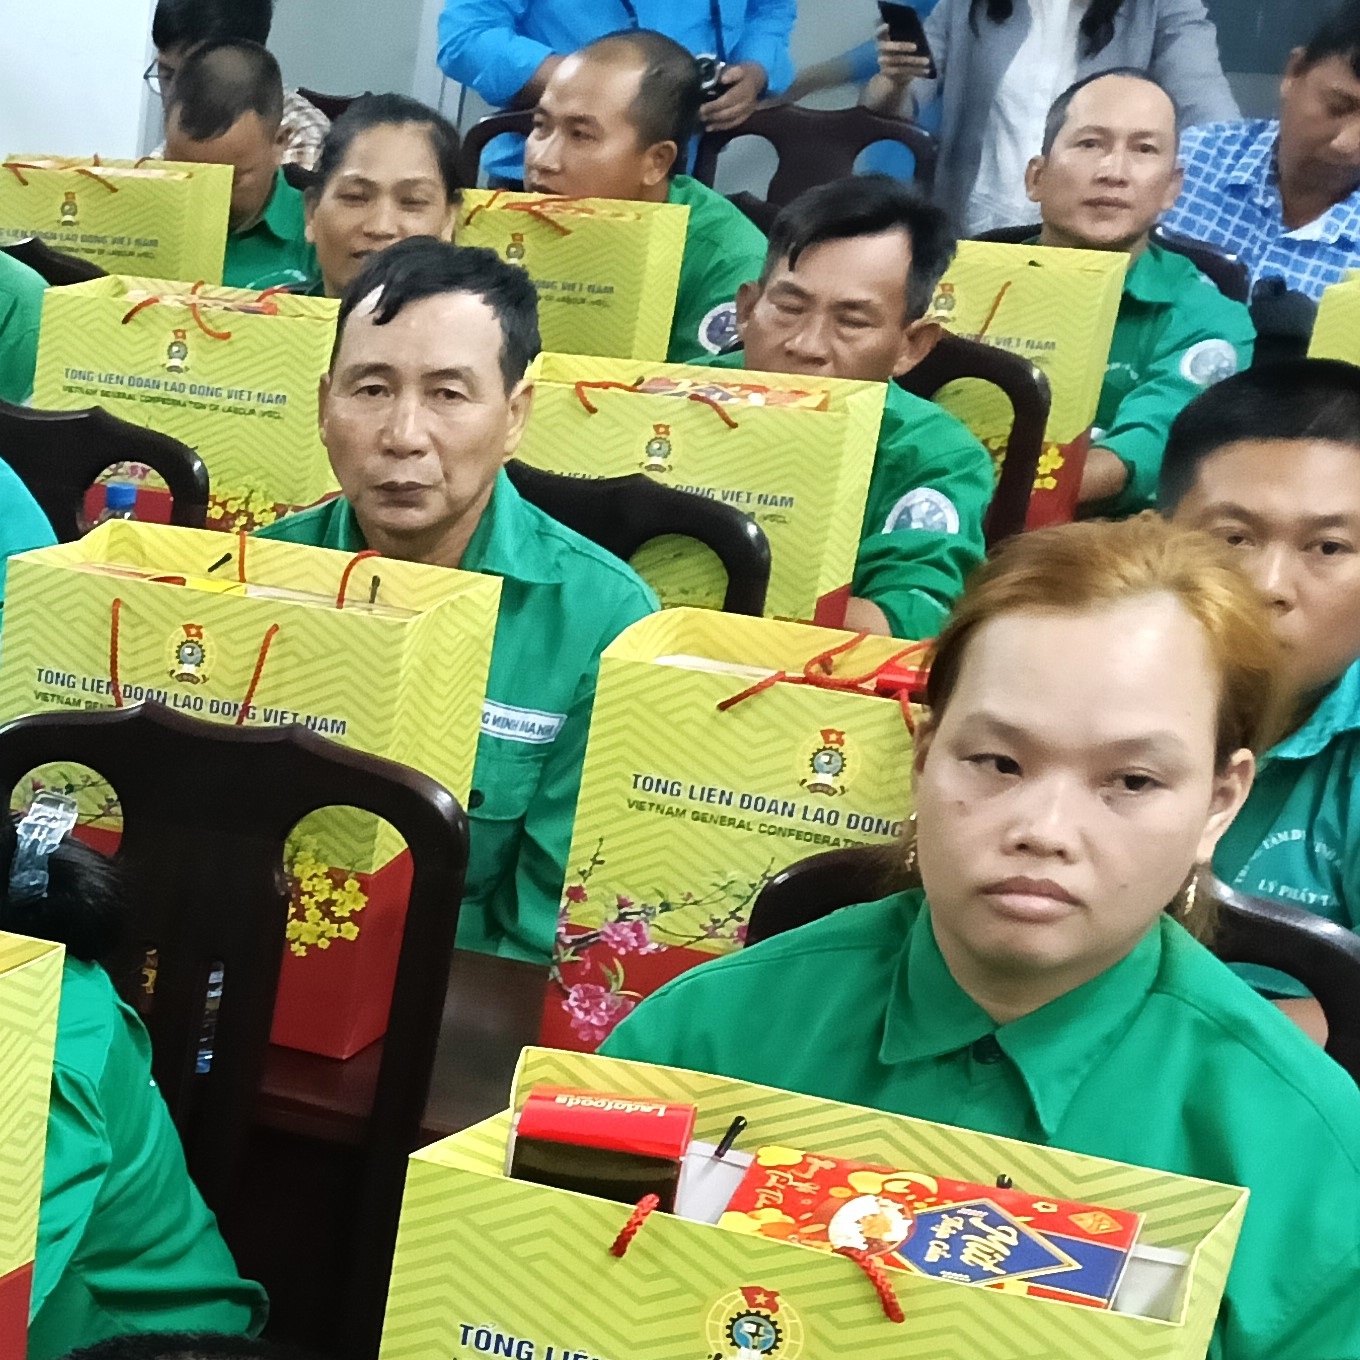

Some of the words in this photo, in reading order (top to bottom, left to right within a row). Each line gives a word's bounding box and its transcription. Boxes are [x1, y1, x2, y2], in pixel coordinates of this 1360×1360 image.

[628, 798, 687, 819] VIETNAM
[691, 810, 753, 831] GENERAL
[802, 804, 840, 827] LAO
[555, 1093, 667, 1117] Ladofoods
